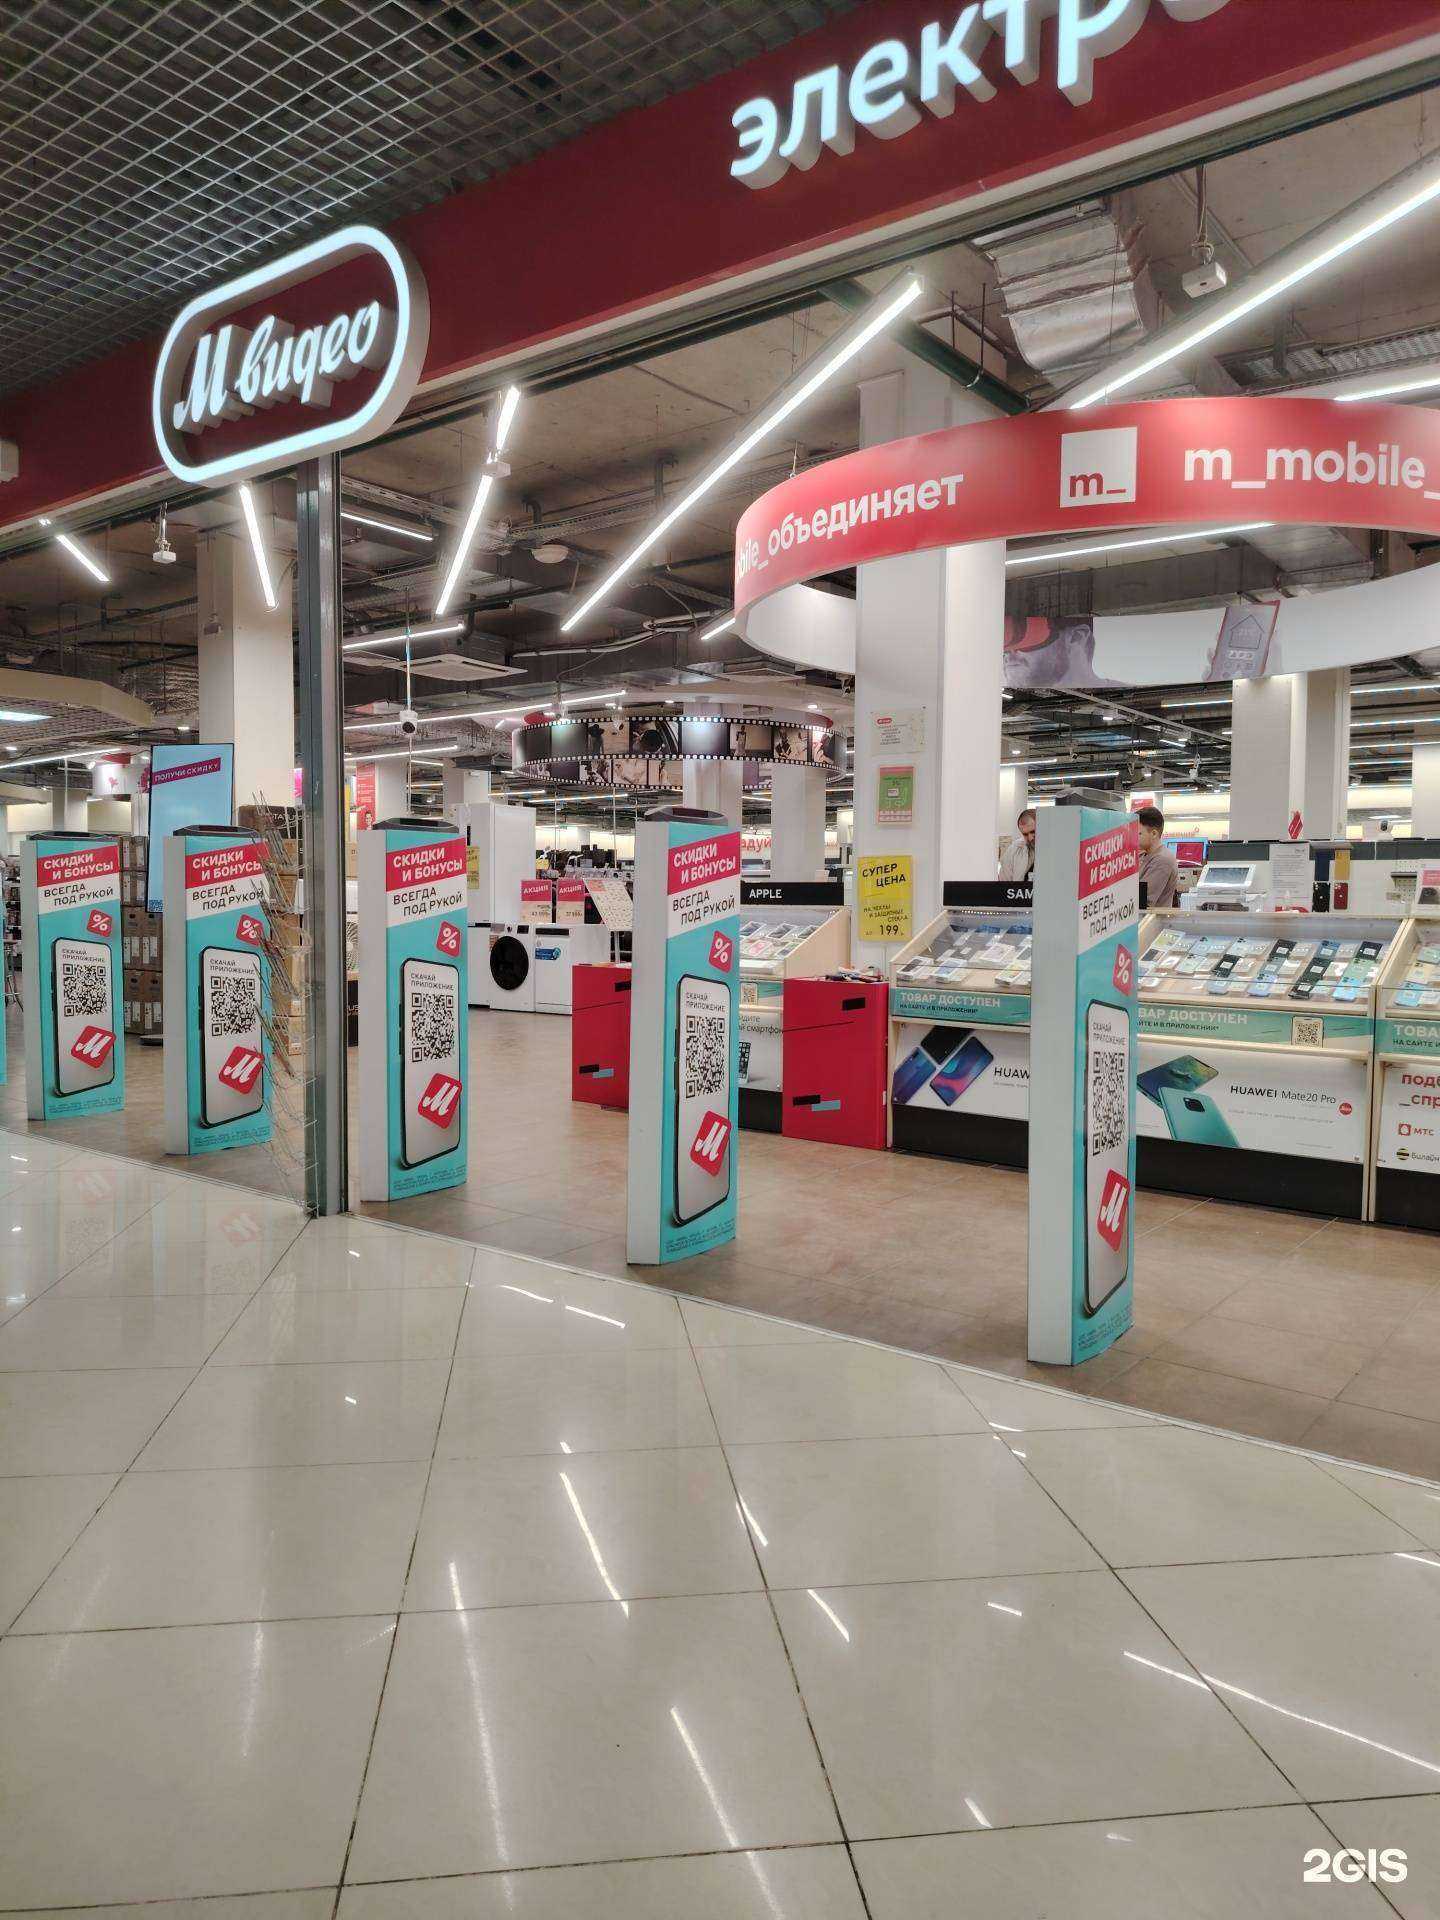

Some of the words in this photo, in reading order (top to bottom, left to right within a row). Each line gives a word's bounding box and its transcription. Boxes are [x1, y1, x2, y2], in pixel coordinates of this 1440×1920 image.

[730, 0, 1180, 178] электр
[186, 763, 219, 774] СКИДКУ
[673, 842, 718, 868] СКИДКИ
[1084, 832, 1124, 864] СКИДКИ
[43, 853, 94, 870] СКИДКИ
[192, 850, 244, 870] СКИДКИ
[393, 847, 445, 868] СКИДКИ
[52, 870, 61, 880] И
[64, 861, 114, 878] БОНУСЫ
[201, 870, 211, 881] И
[402, 869, 412, 882] И
[414, 858, 463, 880] БОНУСЫ
[680, 869, 689, 885] И
[691, 856, 736, 881] БОНУСЫ
[862, 863, 898, 878] СУПЕР
[1089, 866, 1098, 886] И
[1099, 849, 1136, 882] БОНУСЫ
[876, 873, 906, 887] ЦЕНА
[44, 883, 86, 898] ВСЕГДА
[54, 895, 77, 906] ПОД
[79, 886, 114, 901] РУКОЙ
[192, 884, 236, 901] ВСЕГДА
[393, 887, 437, 905] ВСЕГДА
[523, 884, 549, 894] АКЦИЯ
[559, 884, 582, 894] АКЦИЯ
[749, 888, 783, 899] APPLE
[1006, 888, 1034, 900] SAM
[202, 899, 226, 911] ПОД
[403, 903, 427, 917] ПОД
[429, 891, 462, 911] РУКОЙ
[672, 889, 710, 912] ВСЕГДА
[1082, 893, 1115, 920] ВСЕГДА
[681, 907, 701, 926] ПОД
[703, 895, 735, 918] РУКОЙ
[1090, 916, 1107, 938] ПОД
[1108, 898, 1135, 926] РУКОЙ
[879, 924, 899, 936] 199
[209, 958, 236, 966] СКАЧАЙ
[410, 972, 436, 981] СКАЧАЙ
[410, 980, 454, 991] ПРИЛОЖЕНИЕ
[686, 991, 708, 1001] СКАЧАЙ
[900, 992, 936, 1004] ТОВАР
[938, 995, 1001, 1007] ДОСТУПЕН
[686, 1000, 726, 1012] ПРИЛОЖЕНИЕ
[1168, 1009, 1248, 1025] ДОСТУПЕН
[1406, 1039, 1434, 1048] САЙТЕ
[1230, 1085, 1278, 1098] HUAWEI
[1281, 1090, 1318, 1103] Mate20
[1320, 1094, 1337, 1104] Pro
[1413, 1127, 1435, 1136] МТС
